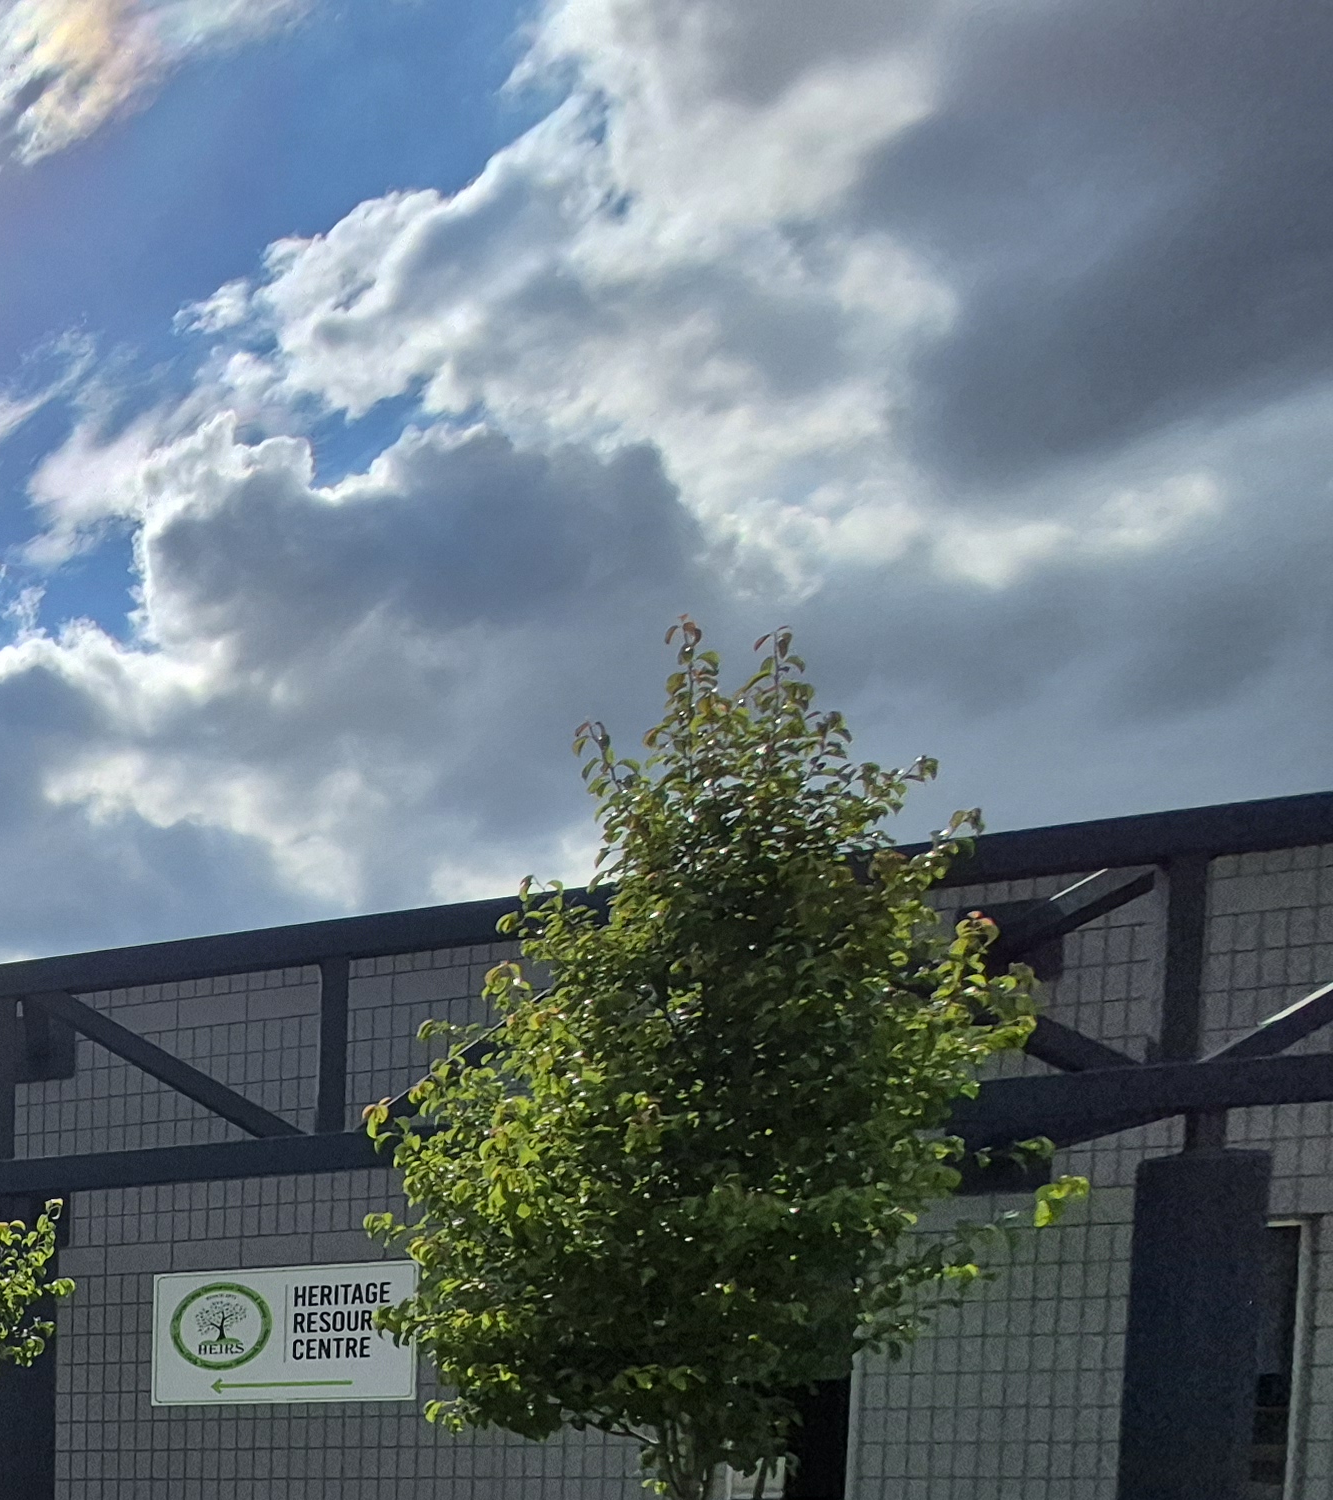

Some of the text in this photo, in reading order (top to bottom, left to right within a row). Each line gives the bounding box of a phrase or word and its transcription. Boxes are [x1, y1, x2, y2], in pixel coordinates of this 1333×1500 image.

[293, 1281, 392, 1307] HERITAGE
[293, 1309, 374, 1334] RESOUR
[197, 1342, 245, 1355] HEIRS
[292, 1336, 371, 1360] CENTRE
